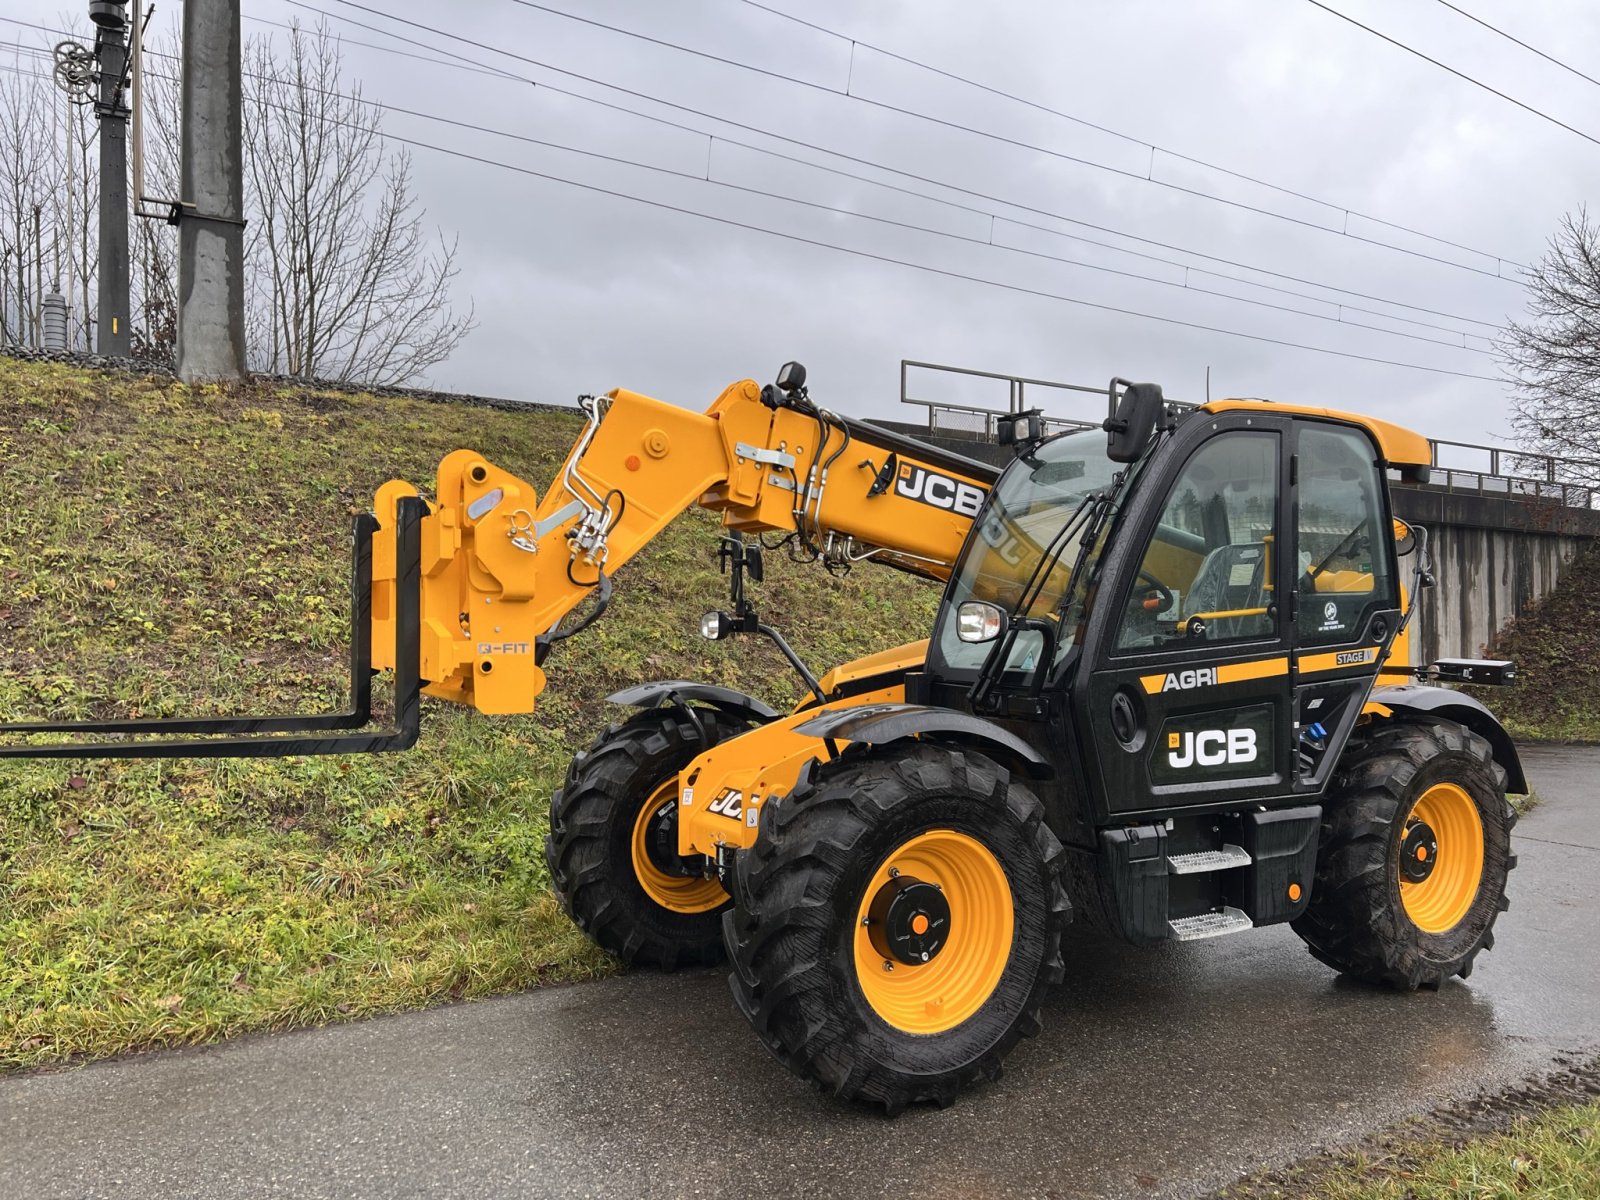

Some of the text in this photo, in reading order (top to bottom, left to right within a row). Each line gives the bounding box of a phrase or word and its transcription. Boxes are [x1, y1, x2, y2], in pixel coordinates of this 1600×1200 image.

[898, 469, 985, 517] JCB
[1337, 651, 1364, 664] STAGE
[1163, 667, 1217, 692] AGRI
[1168, 728, 1257, 768] JCB
[709, 790, 742, 819] JC
